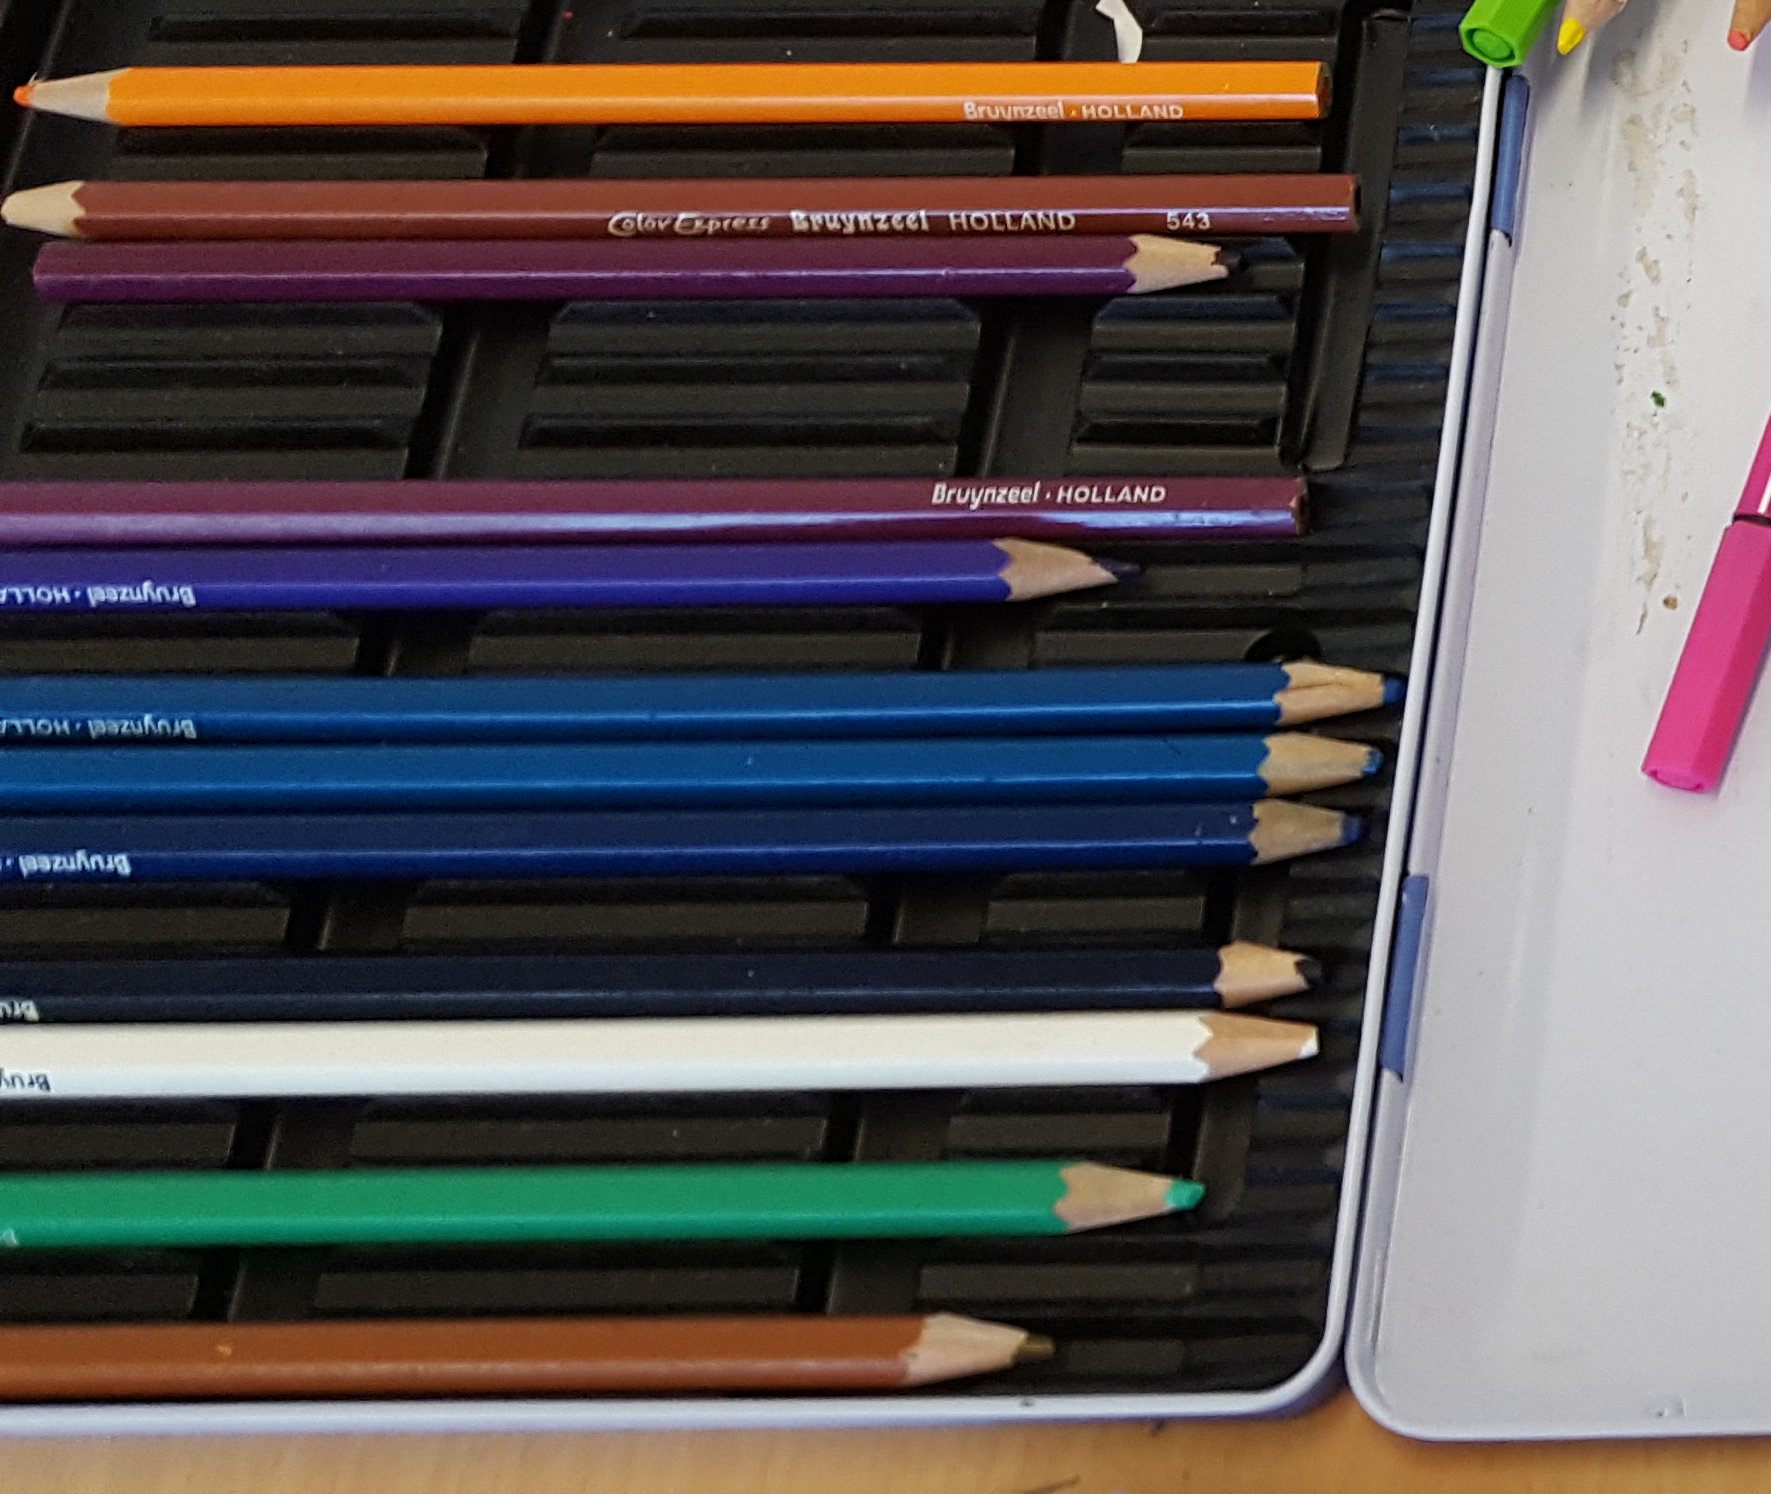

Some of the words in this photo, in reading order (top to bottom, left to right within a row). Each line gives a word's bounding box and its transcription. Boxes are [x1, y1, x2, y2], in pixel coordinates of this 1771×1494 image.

[962, 100, 1065, 120] Bruynzeel
[1081, 103, 1184, 119] HOLLAND
[790, 209, 929, 234] Bruynzeel
[948, 211, 1075, 231] HOLLAND
[1166, 210, 1211, 229] 543
[931, 481, 1041, 509] Bruynzeel
[1056, 485, 1166, 503] HOLLAND
[86, 578, 195, 608] Bruynzeel
[87, 713, 196, 739] Bruynzeel
[18, 847, 131, 880] Bruynzeel
